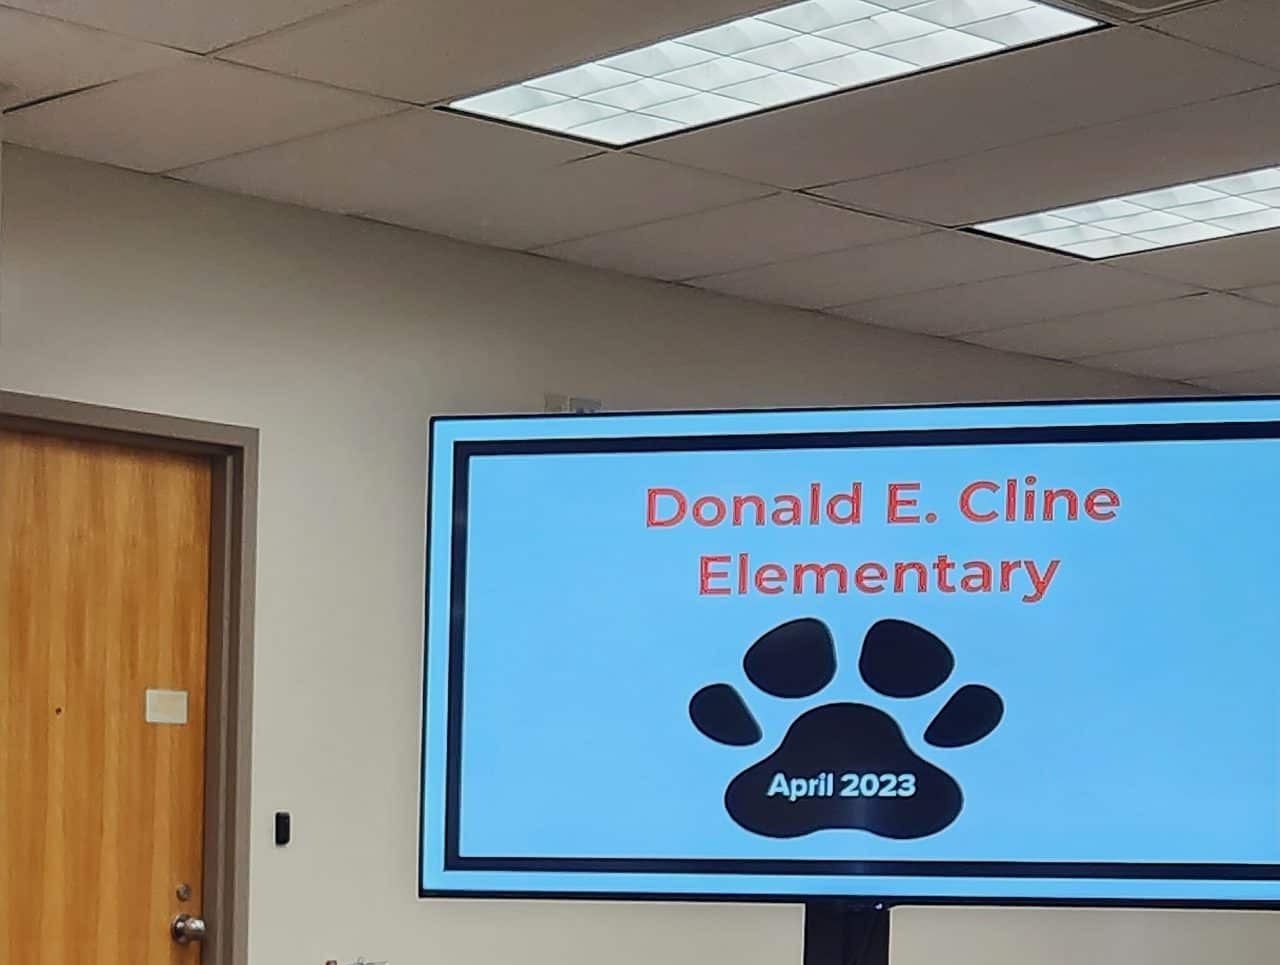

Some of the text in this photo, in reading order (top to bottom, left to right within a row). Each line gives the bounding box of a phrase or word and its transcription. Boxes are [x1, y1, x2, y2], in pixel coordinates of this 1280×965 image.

[646, 475, 1121, 528] Donald E. Cline
[698, 553, 1061, 603] Elementary
[767, 772, 917, 802] April 2023
